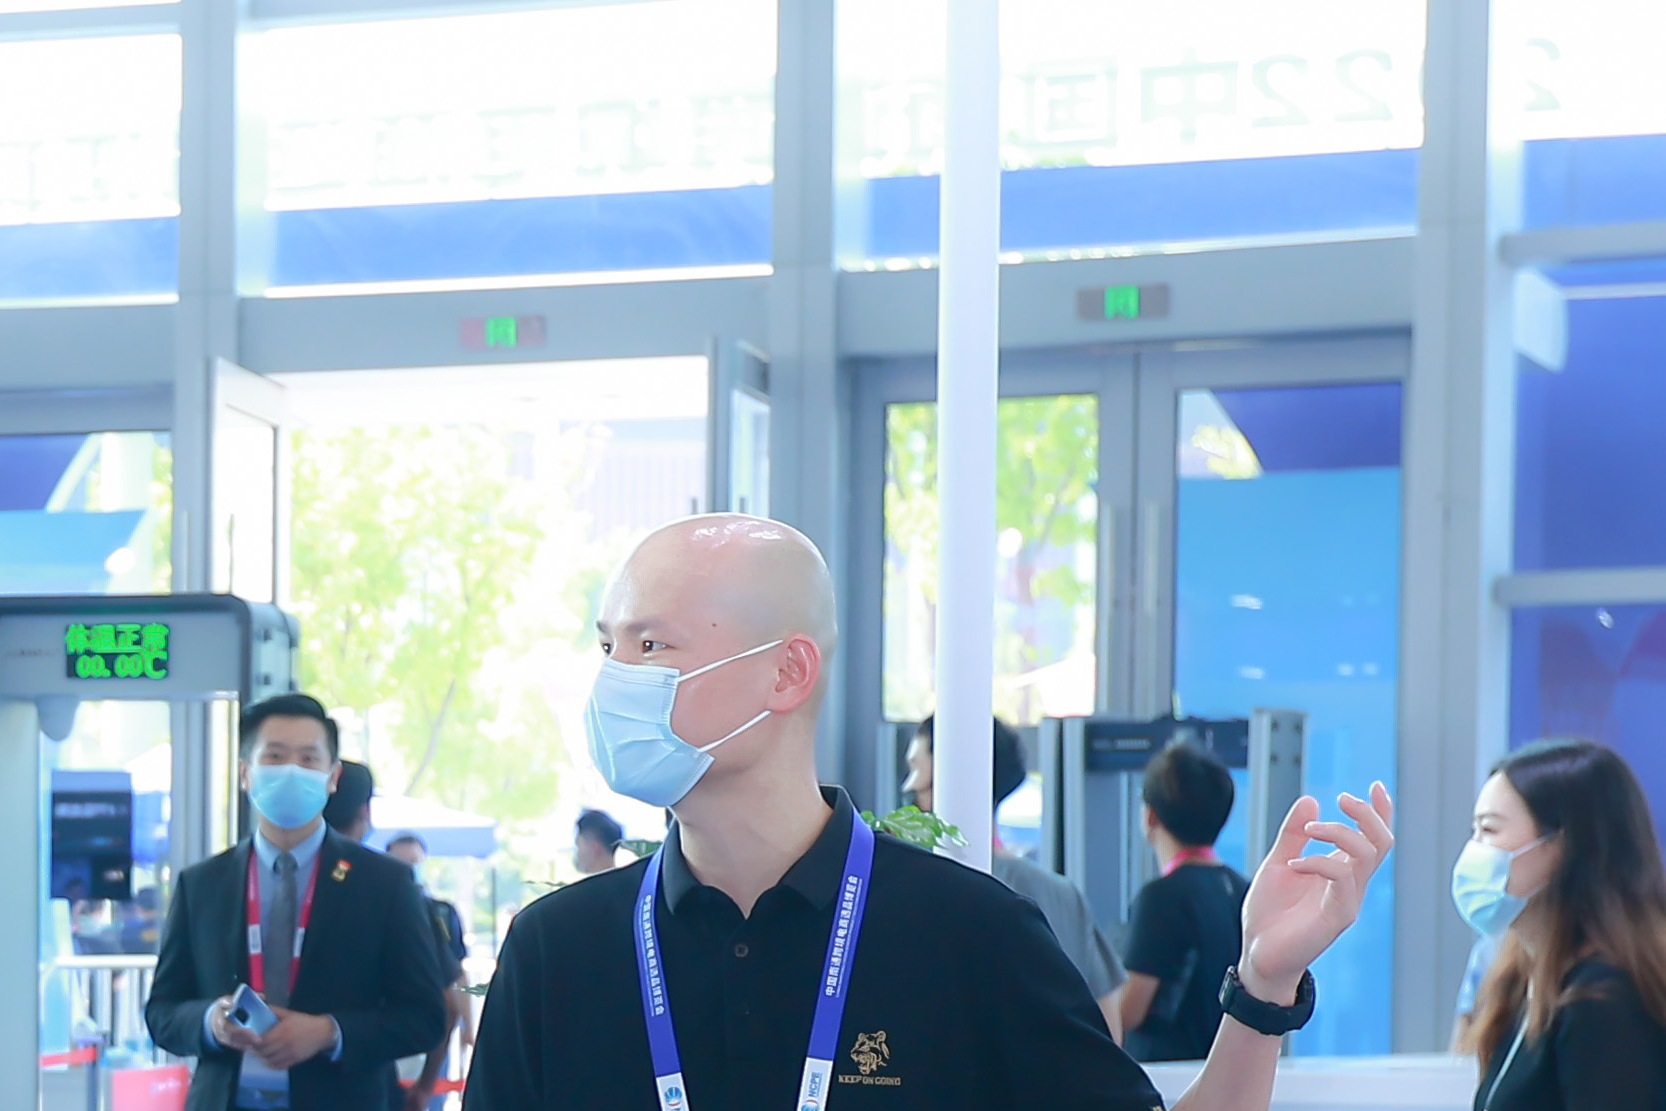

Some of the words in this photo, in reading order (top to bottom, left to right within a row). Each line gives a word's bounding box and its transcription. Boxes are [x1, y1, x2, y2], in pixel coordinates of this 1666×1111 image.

[65, 623, 170, 655] 体温正常
[825, 875, 859, 997] 中国南通跨境电商选品博览会
[642, 894, 665, 1016] 中国南通跨境电商选品博览会
[808, 1071, 821, 1098] NCPE
[838, 1074, 862, 1084] KEEP
[862, 1076, 874, 1085] ON
[874, 1077, 902, 1086] GOING
